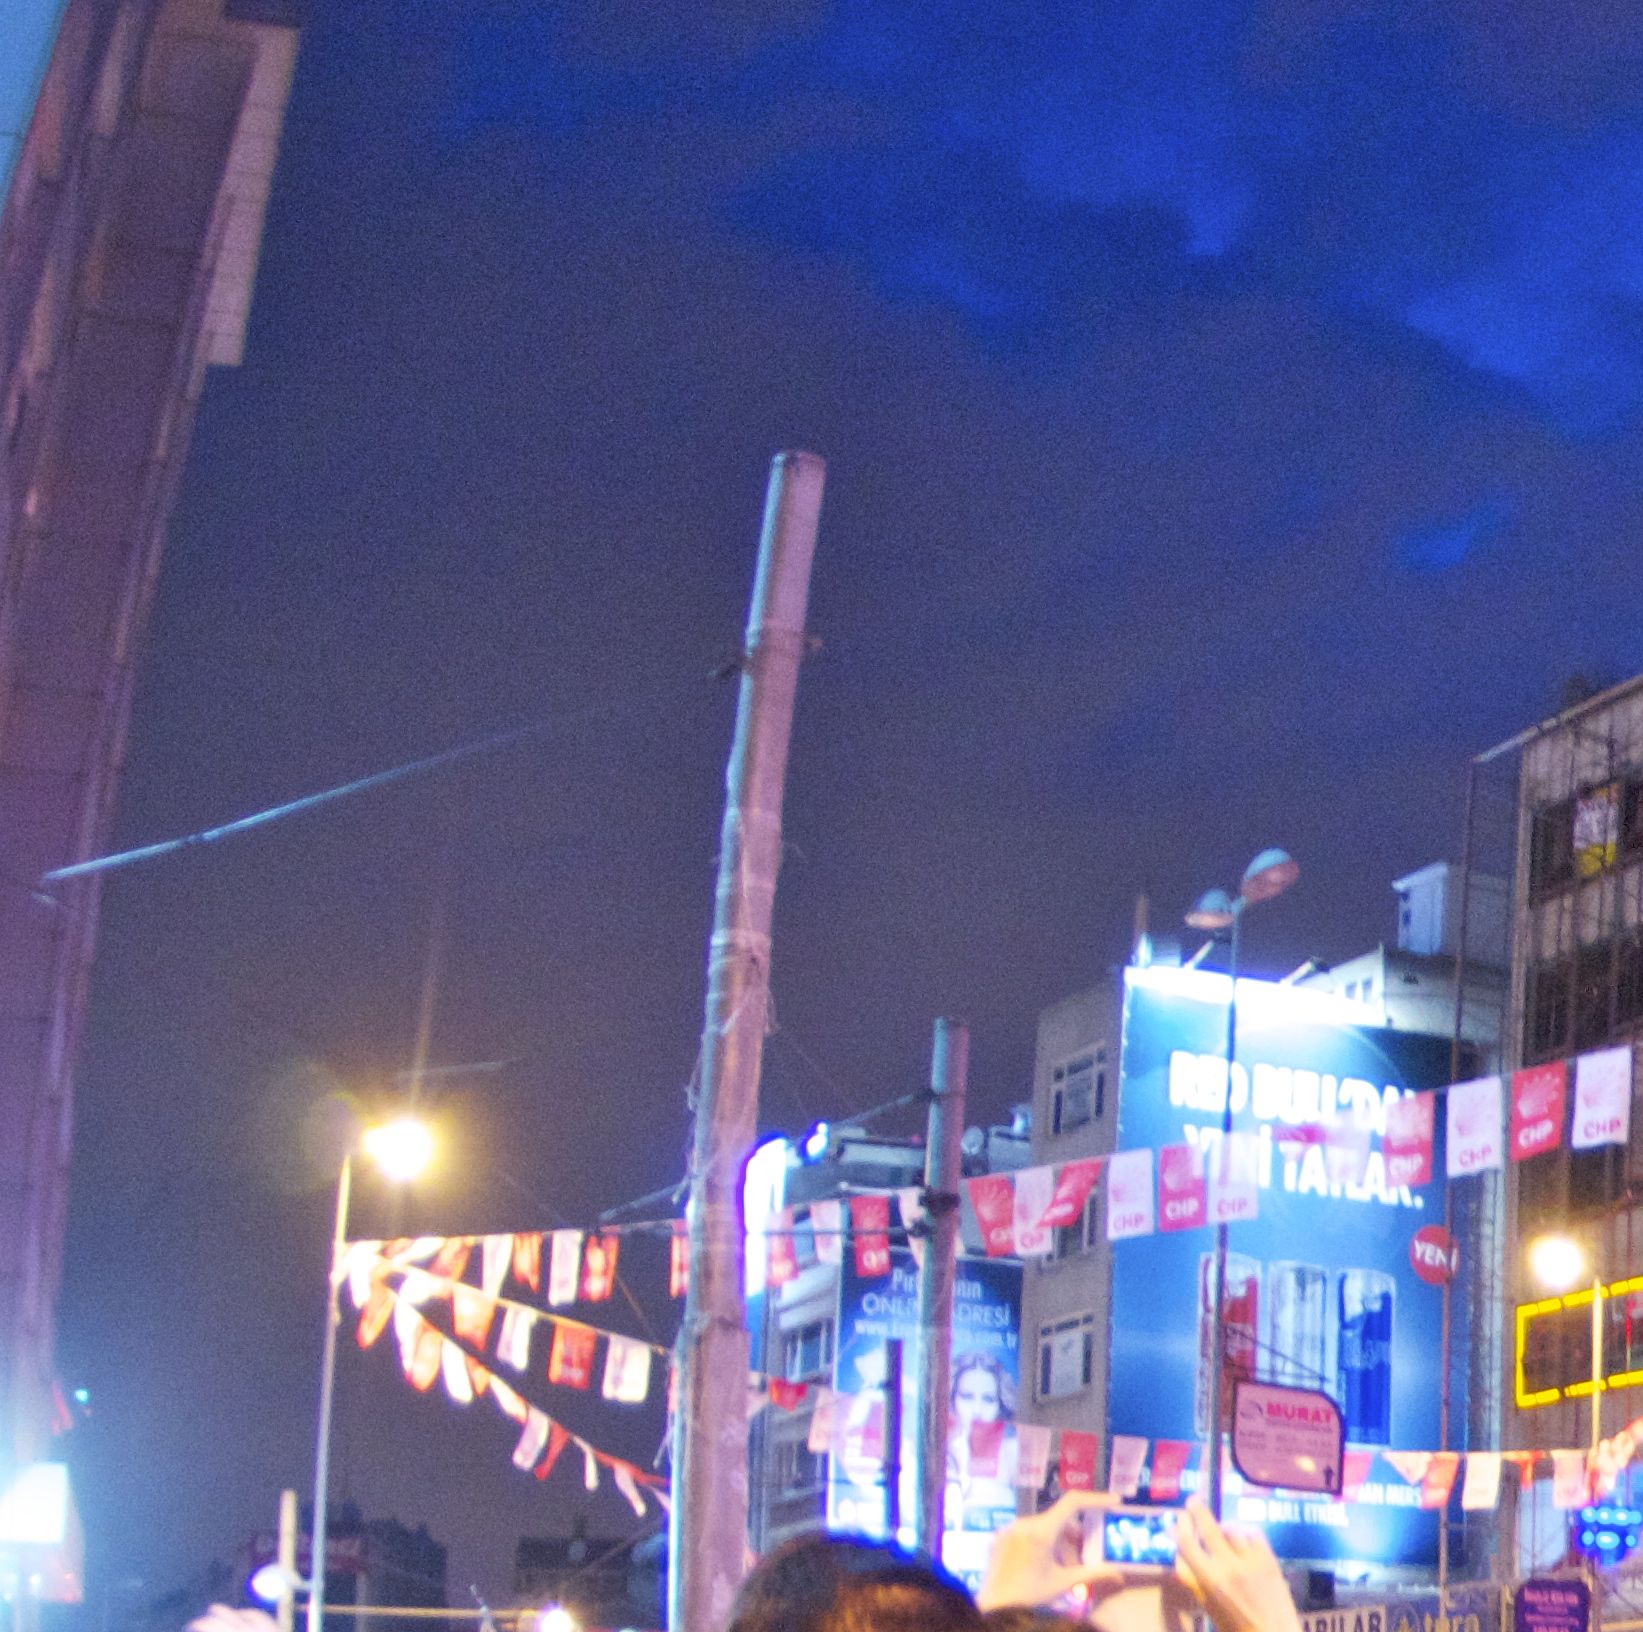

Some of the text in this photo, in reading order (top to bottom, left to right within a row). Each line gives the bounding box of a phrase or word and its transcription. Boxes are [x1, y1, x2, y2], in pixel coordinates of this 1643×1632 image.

[1519, 1118, 1555, 1148] CHP
[1583, 1118, 1622, 1140] CHP
[1458, 1146, 1493, 1169] CHP
[1165, 1197, 1200, 1222] CHP
[1113, 1213, 1144, 1232] CHP
[1265, 1402, 1333, 1426] MURAT
